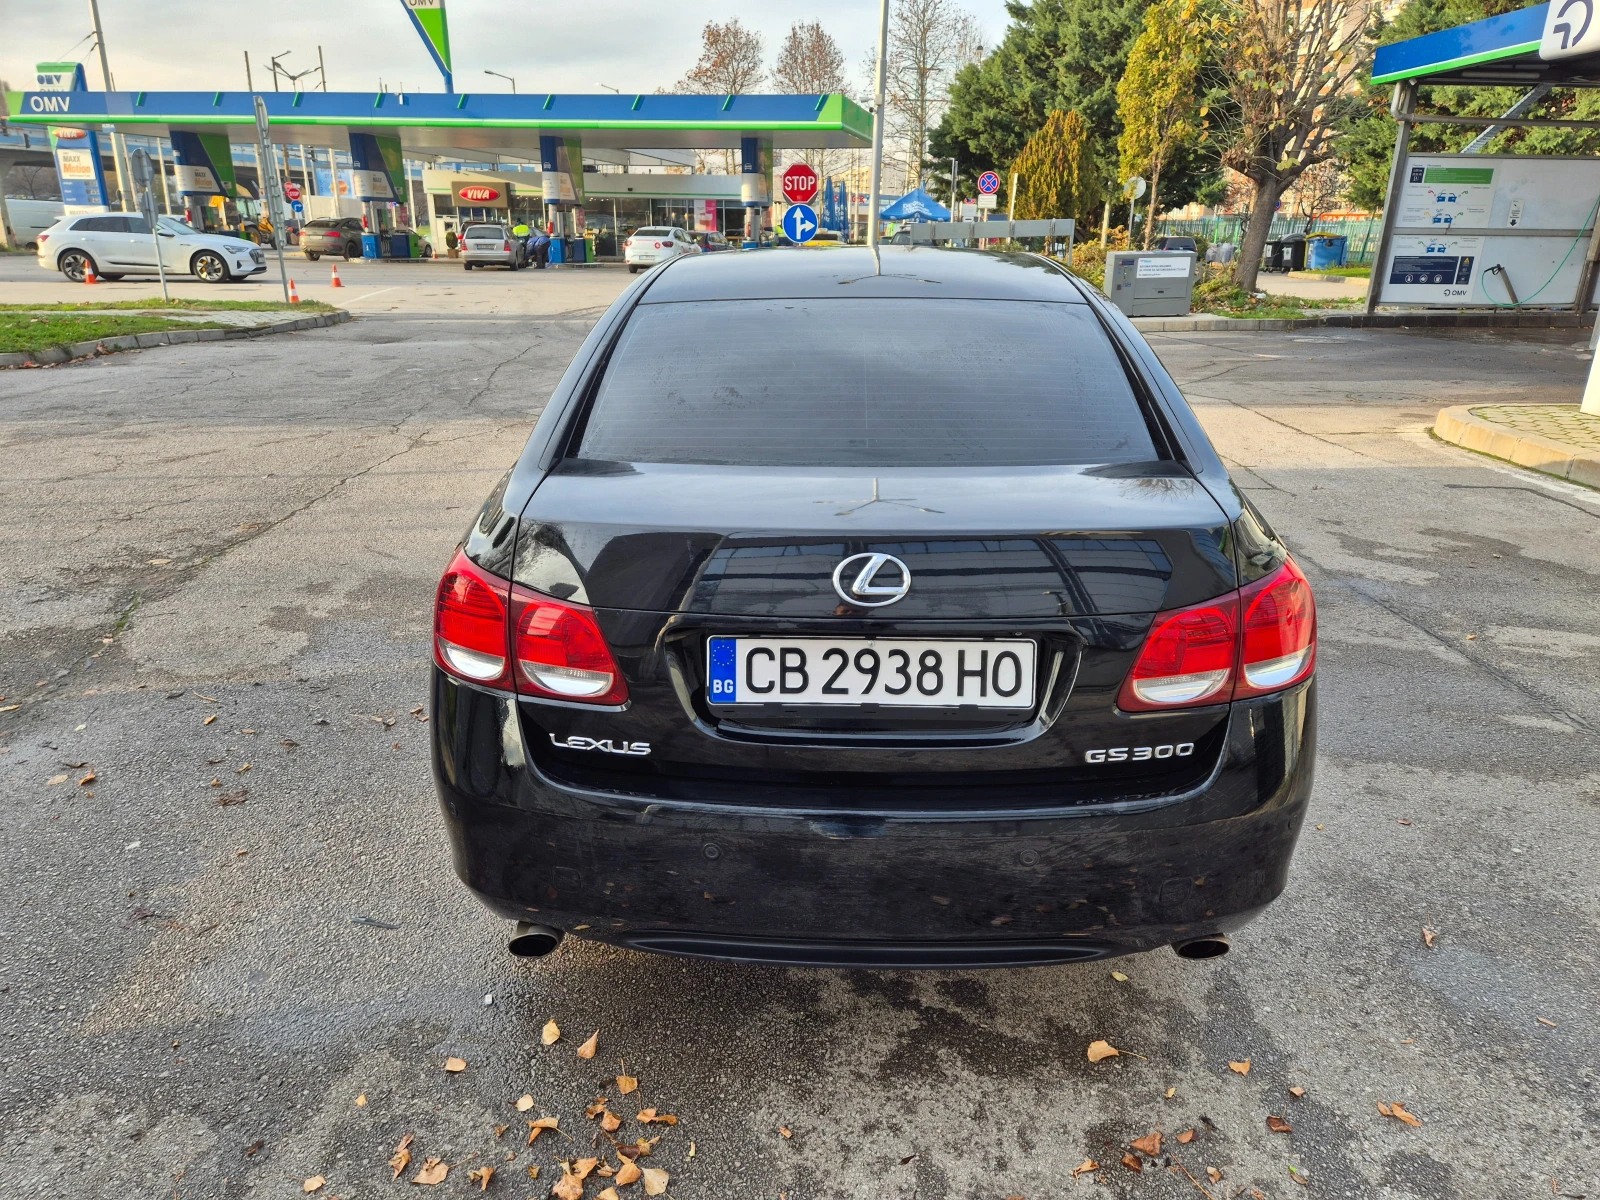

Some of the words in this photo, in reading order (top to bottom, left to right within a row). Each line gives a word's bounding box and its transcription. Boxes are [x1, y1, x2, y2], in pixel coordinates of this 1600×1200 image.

[30, 96, 70, 112] OMV
[63, 155, 80, 163] MAXX
[63, 163, 91, 174] Motion
[784, 175, 815, 191] STOP
[467, 188, 490, 199] VIVA
[745, 646, 810, 695] CB
[821, 647, 943, 697] 2938
[956, 649, 1022, 697] HO
[712, 678, 734, 694] BG
[549, 732, 652, 755] LEXUS
